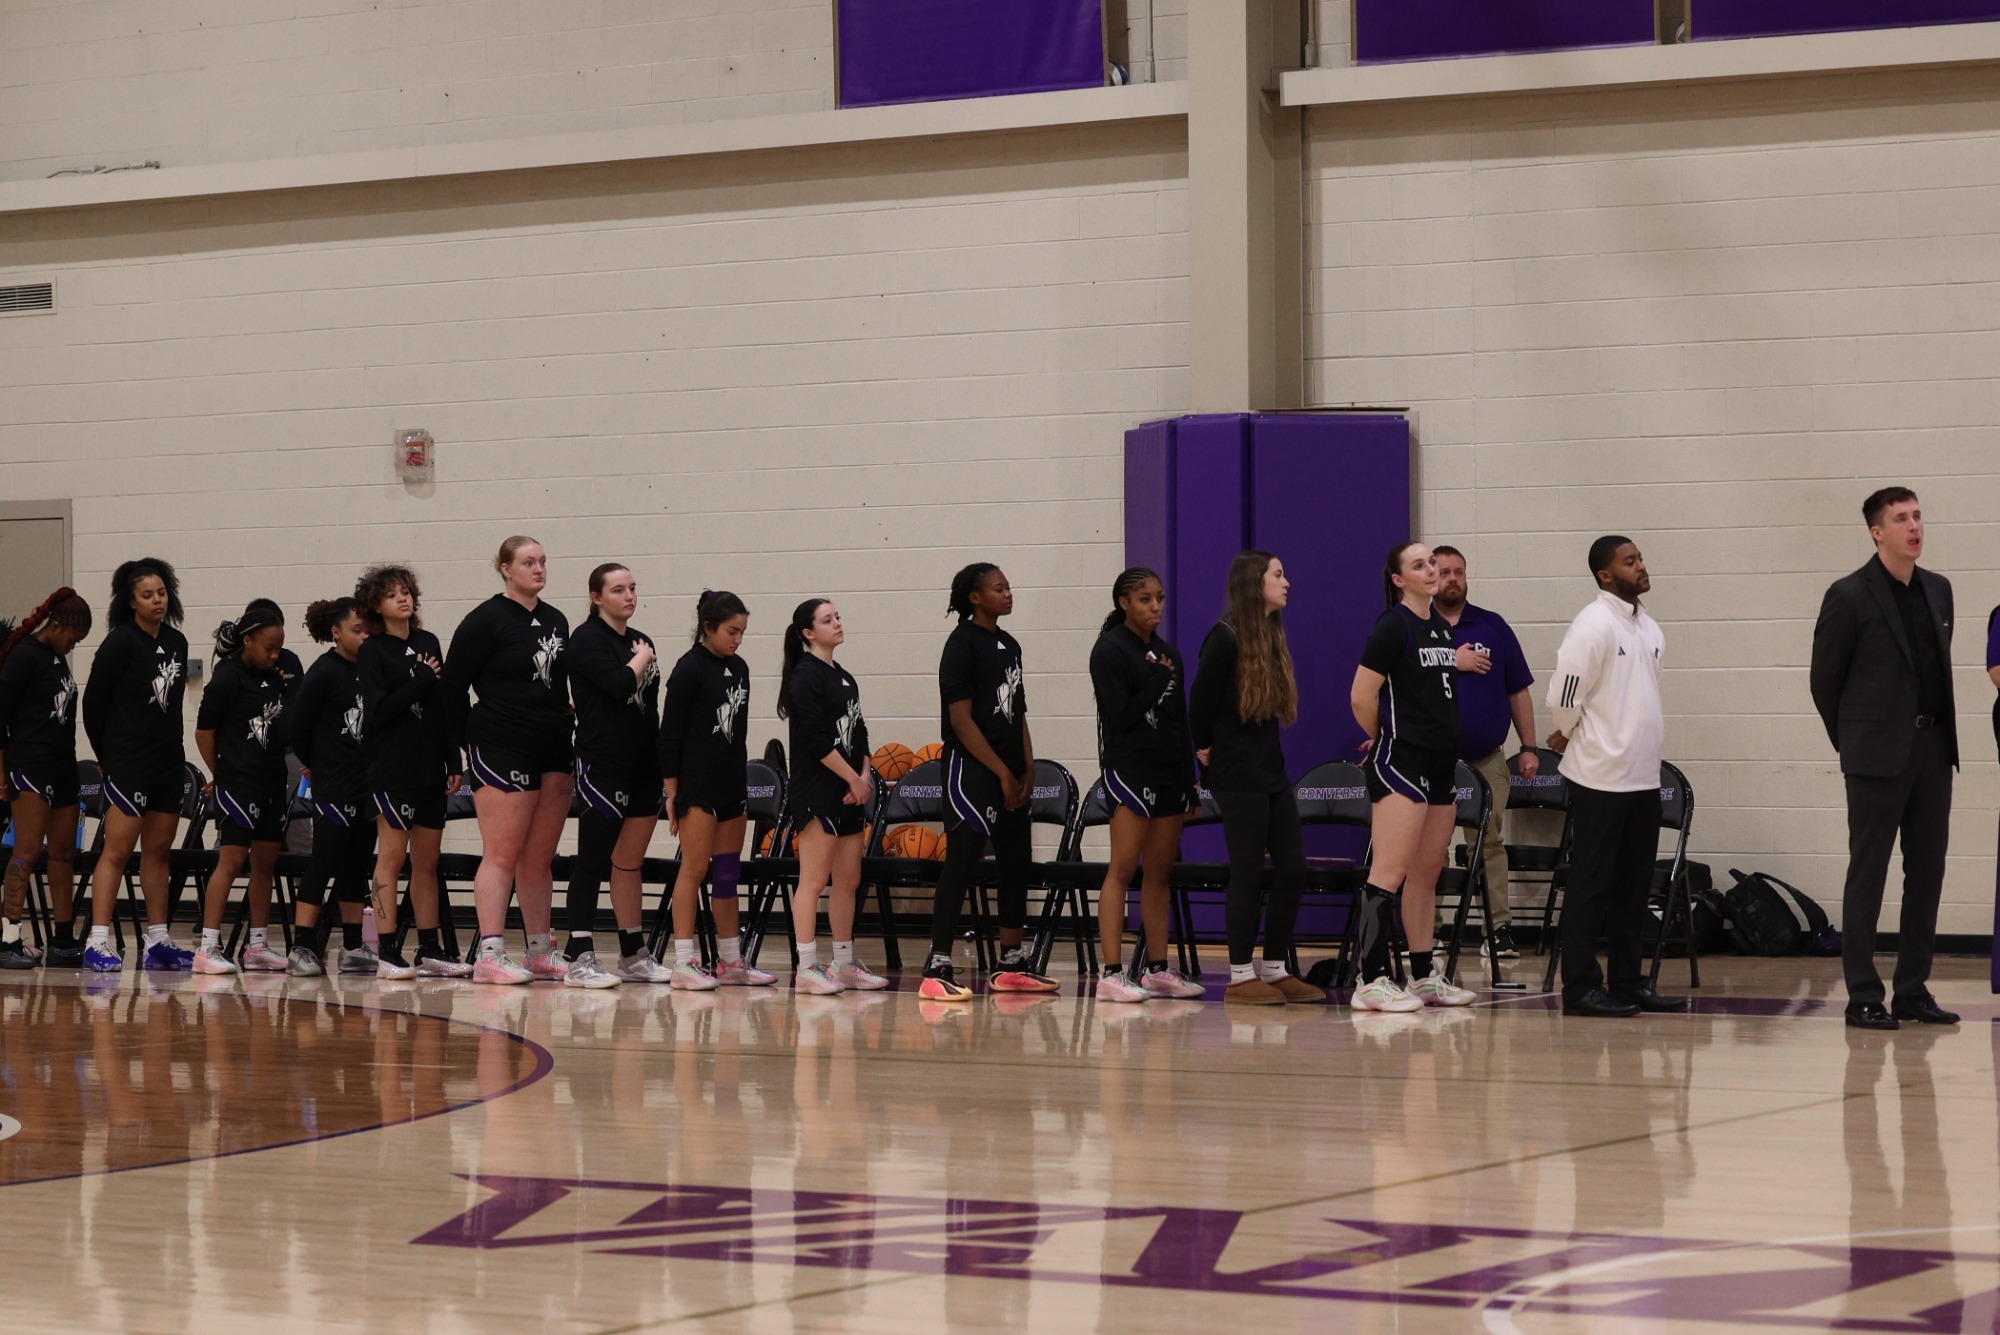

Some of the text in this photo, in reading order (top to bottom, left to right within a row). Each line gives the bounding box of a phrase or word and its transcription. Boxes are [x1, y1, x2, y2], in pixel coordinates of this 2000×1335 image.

[1418, 647, 1456, 667] CONVERS
[1442, 672, 1453, 699] 5
[510, 770, 529, 785] CU
[1509, 775, 1562, 786] ONVERSE
[615, 791, 629, 806] CU
[746, 785, 775, 798] ERSE
[900, 785, 943, 798] CONVE
[1030, 786, 1061, 798] ERSE
[1143, 787, 1156, 805] CU
[1297, 786, 1366, 800] CONVERSE
[134, 792, 147, 807] CU
[249, 803, 260, 818] CU
[401, 804, 415, 819] CU
[986, 806, 997, 823] CU
